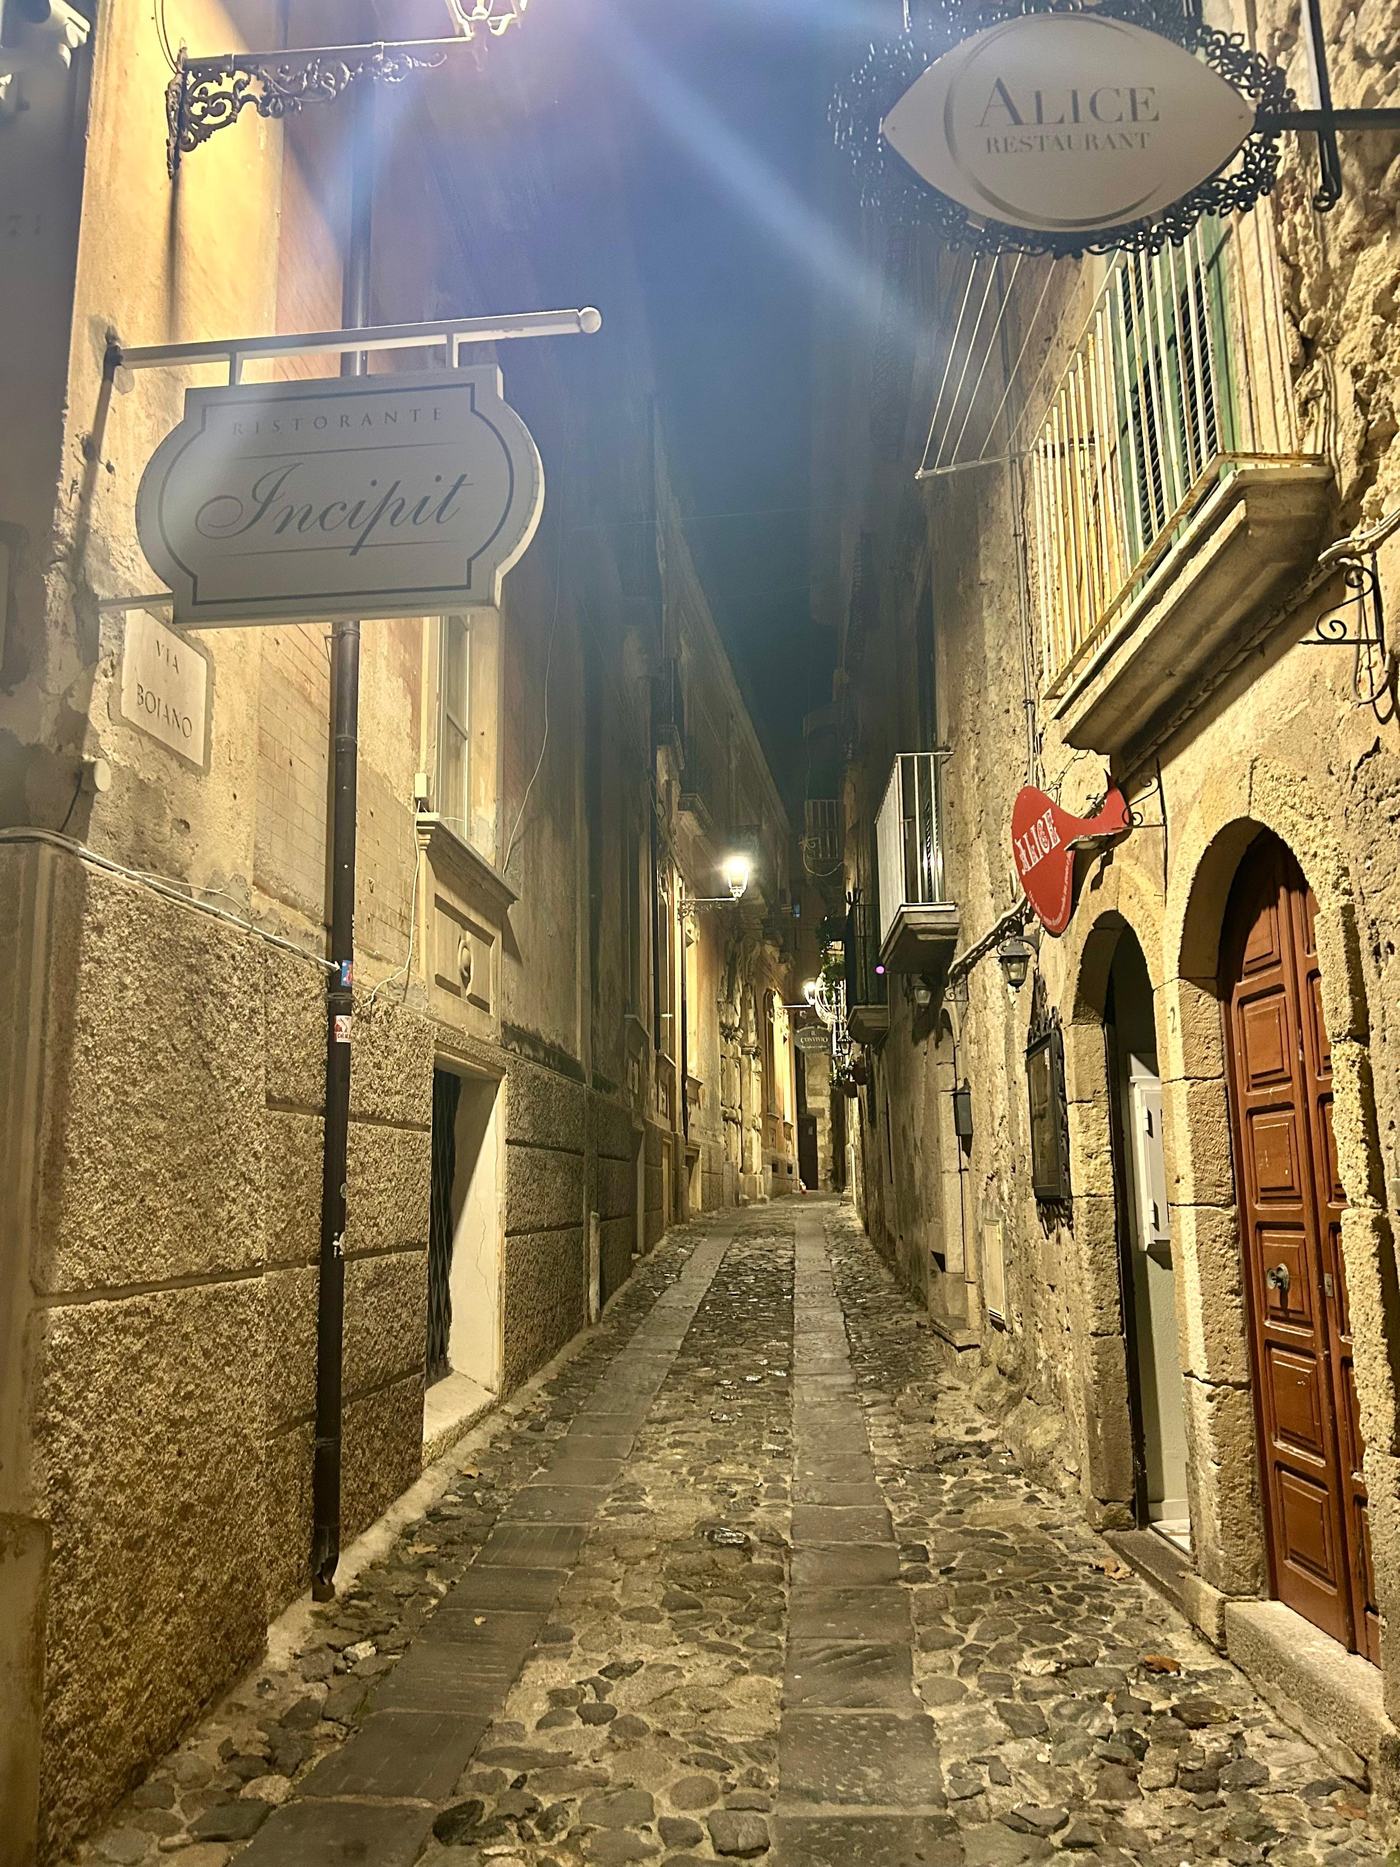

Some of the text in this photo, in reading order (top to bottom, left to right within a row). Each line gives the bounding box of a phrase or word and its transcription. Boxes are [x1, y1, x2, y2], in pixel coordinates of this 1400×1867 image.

[986, 131, 1151, 155] RESTAURANT
[232, 407, 442, 436] RISTORANTE
[194, 462, 474, 557] Incipit
[155, 639, 180, 675] VIA
[136, 682, 193, 739] BOIANO
[1014, 807, 1062, 876] ALICE
